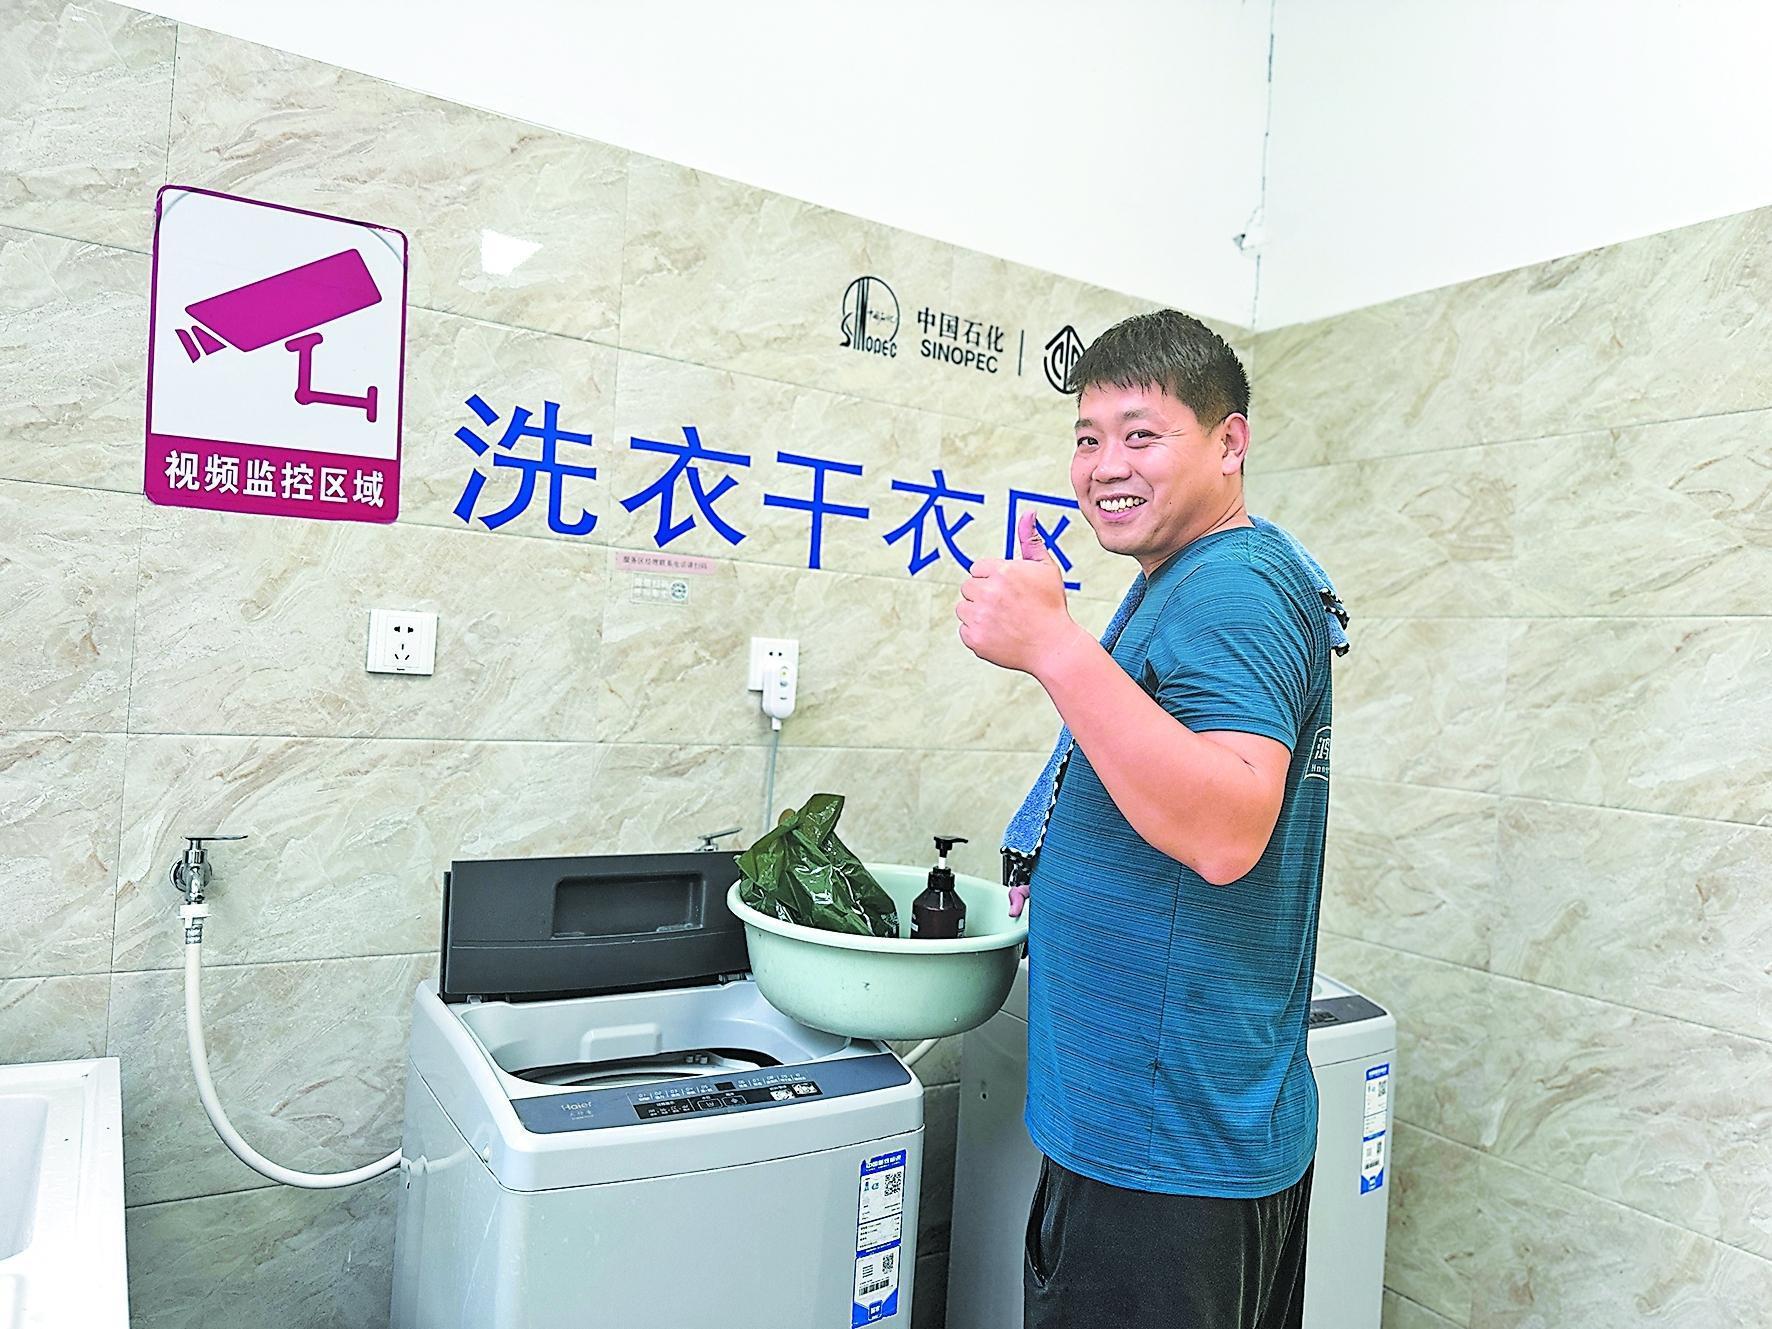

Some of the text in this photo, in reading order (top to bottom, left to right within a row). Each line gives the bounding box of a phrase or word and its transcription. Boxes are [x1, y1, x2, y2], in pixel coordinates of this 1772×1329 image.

[917, 307, 1004, 353] 中国石化
[920, 338, 999, 374] SINOPEC
[164, 449, 385, 508] 视频监控区域
[454, 394, 1082, 591] 洗衣干衣区
[560, 1101, 592, 1112] Haier
